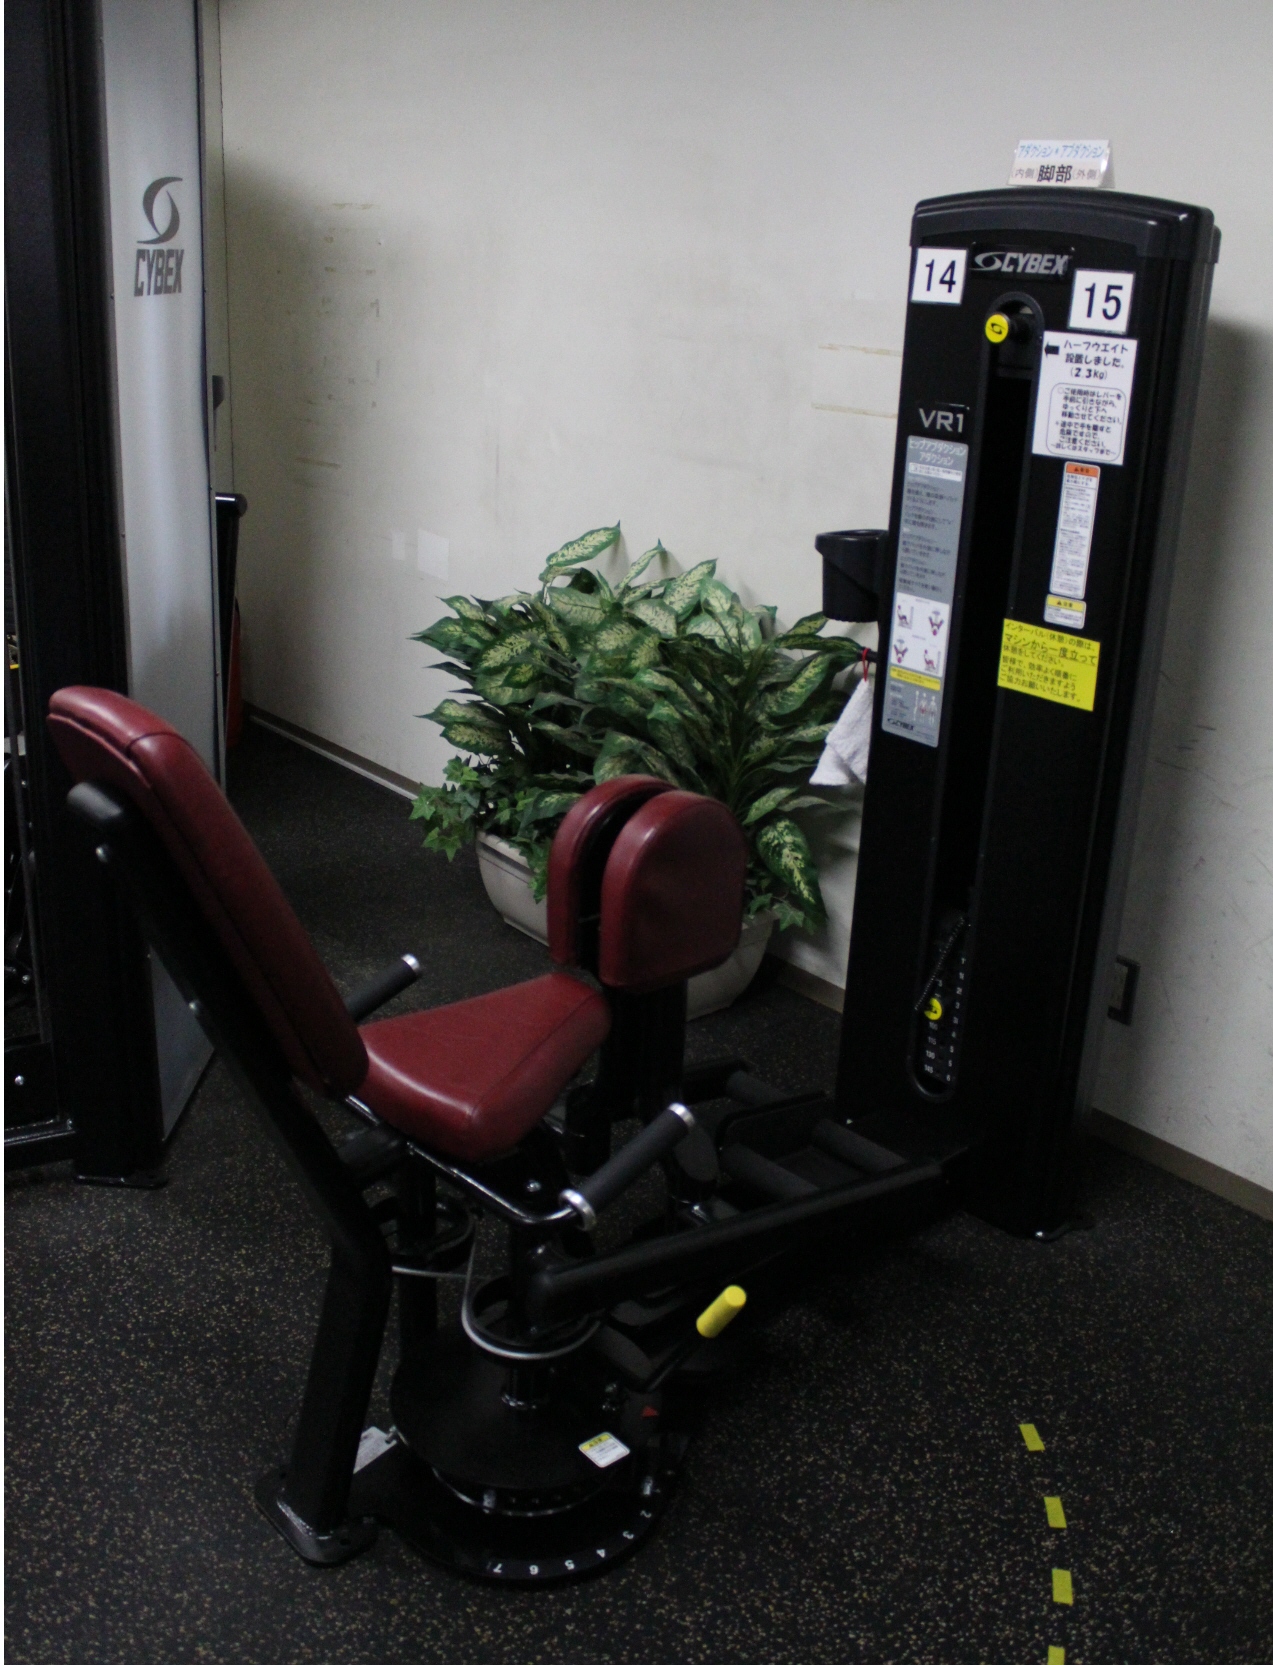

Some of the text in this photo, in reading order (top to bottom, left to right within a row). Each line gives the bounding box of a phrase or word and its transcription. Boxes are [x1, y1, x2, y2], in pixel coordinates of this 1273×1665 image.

[1037, 164, 1073, 183] 脚部
[134, 248, 185, 297] CYBEX
[1001, 252, 1070, 275] CYBEX
[925, 259, 956, 293] 14
[1085, 282, 1123, 321] 15
[1064, 340, 1128, 354] ハーフウエイト
[1065, 352, 1125, 369] 設置しました。
[919, 408, 964, 433] VR1
[1005, 633, 1097, 666] マシンから一度立って
[564, 1559, 575, 1570] 5
[596, 1548, 606, 1558] 4
